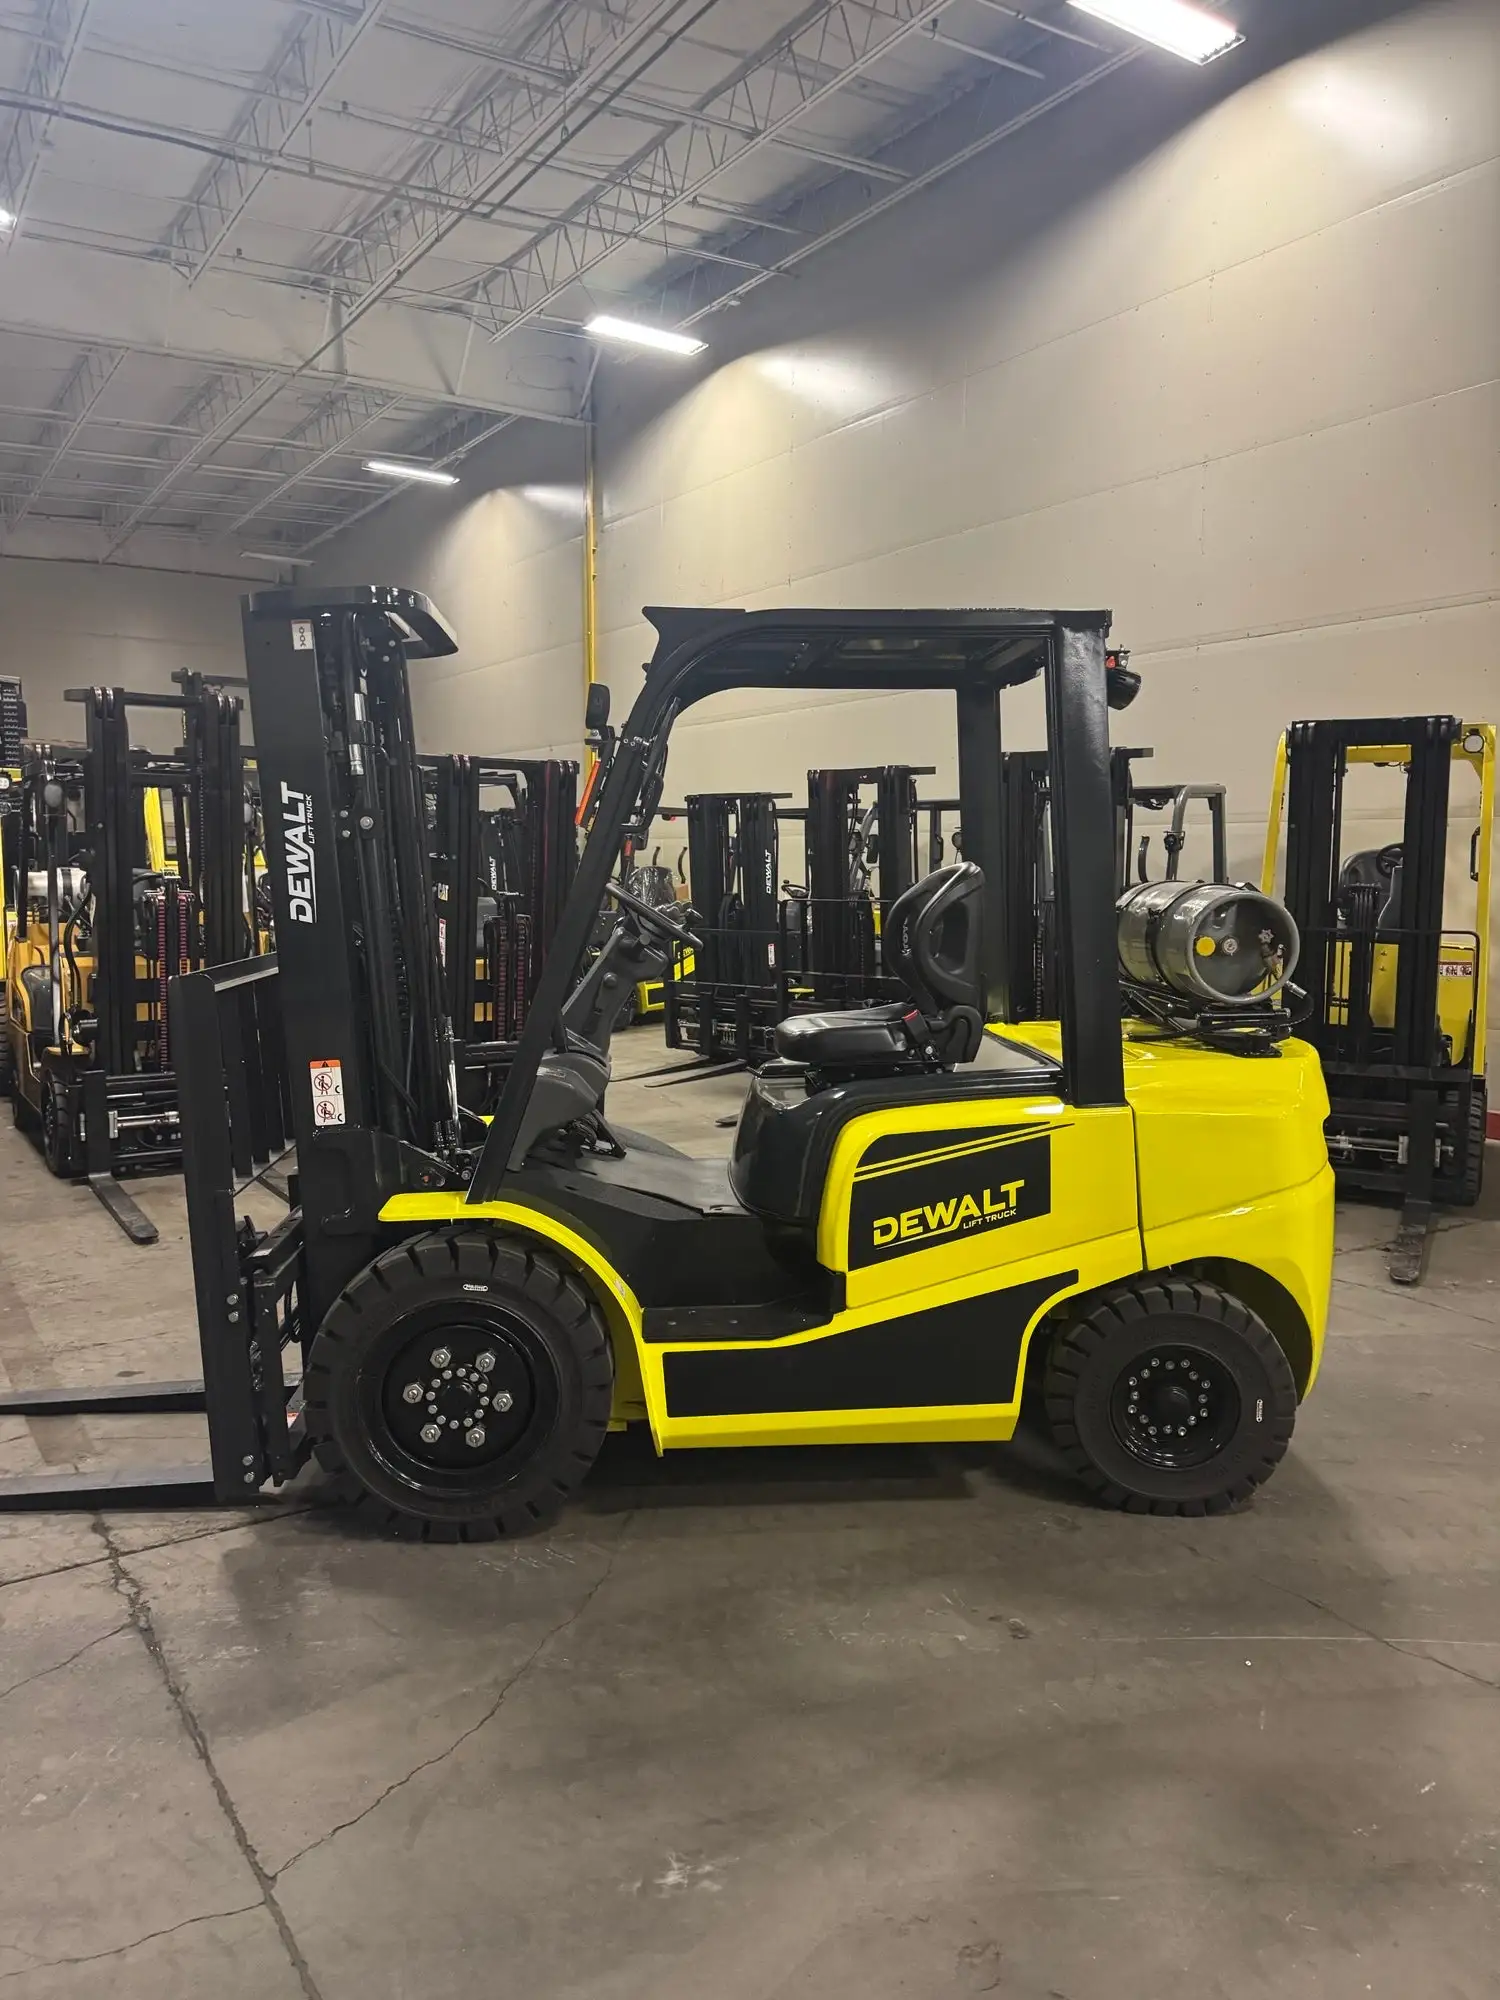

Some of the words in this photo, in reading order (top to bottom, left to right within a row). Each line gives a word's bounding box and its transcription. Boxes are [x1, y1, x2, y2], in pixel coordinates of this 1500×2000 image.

[305, 794, 313, 823] TRUCK
[280, 781, 317, 923] DEWALT
[307, 826, 315, 844] LIFT
[488, 856, 497, 890] DEWALT
[764, 849, 772, 894] DEWALT
[873, 1179, 1025, 1249] DEWALT
[963, 1217, 983, 1229] LIFT
[985, 1208, 1017, 1224] TRUCK
